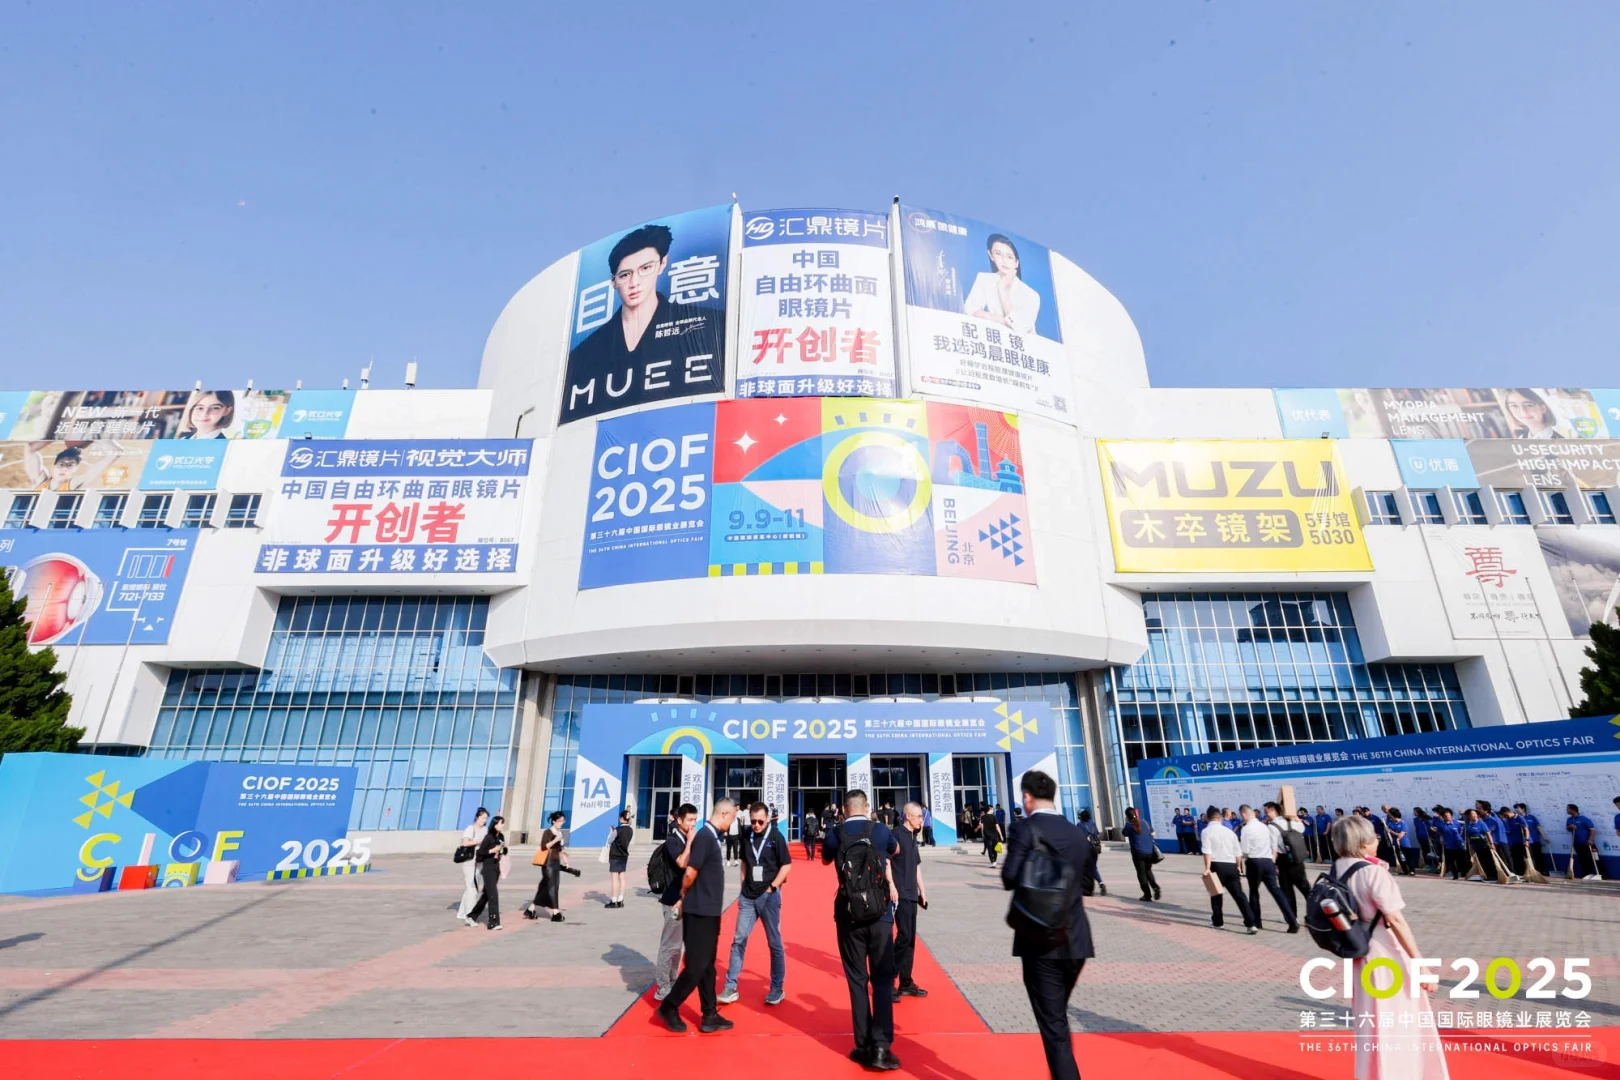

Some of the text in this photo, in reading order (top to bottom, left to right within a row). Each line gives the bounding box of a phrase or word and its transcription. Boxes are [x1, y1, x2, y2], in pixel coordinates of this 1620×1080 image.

[778, 217, 886, 240] 汇鼎镜片
[791, 249, 840, 269] 中国
[668, 254, 720, 305] 意
[755, 274, 878, 297] 自由环曲面
[778, 296, 853, 319] 眼镜片
[751, 326, 882, 365] 开创者
[933, 335, 1051, 376] 我选鸿晨眼健康
[569, 353, 713, 411] MUEE
[739, 378, 893, 398] 非球面升级好选择
[61, 406, 108, 418] NEW
[1383, 400, 1438, 410] MYOPIA
[54, 421, 156, 434] 近视管理镜片
[1387, 412, 1485, 423] MANAGEMENT
[1391, 425, 1425, 435] LENS
[315, 449, 401, 468] 汇鼎镜片
[406, 448, 528, 468] 视觉大师
[597, 433, 709, 480] CIOF
[1511, 444, 1604, 455] U-SECURITY
[281, 479, 521, 500] 中国自由环曲面眼镜片
[1109, 461, 1340, 498] MUZU
[1523, 473, 1562, 486] LENS
[591, 473, 706, 523] 2025
[324, 501, 466, 544] 开创者
[589, 519, 705, 540] 第三十六届中国国际眼镜业展览会
[729, 508, 804, 530] 9.9-11
[1133, 512, 1294, 544] 木卒镜架
[1305, 511, 1351, 528] 5号馆
[943, 498, 960, 565] BEIJING
[1309, 529, 1355, 545] 5030
[627, 539, 668, 549] INTERNATIONAL
[962, 541, 975, 566] 北京
[261, 548, 513, 572] 非球面升级好选择
[723, 718, 857, 740] CIOF 2025
[864, 718, 986, 729] 第三十六届中国国际眼镜业展览会
[1191, 735, 1595, 773] CIOF 2025 第三十六届中国国际眼镜业展览会 THE 36TH CHINA INTERNATIONAL OPTICS FAIR
[242, 775, 340, 791] CIOF 2025
[581, 777, 611, 799] 1A
[683, 773, 691, 802] WELCO
[932, 772, 942, 813] WELCOME
[941, 772, 953, 813] 欢迎参观
[79, 829, 244, 869] CIOF
[275, 837, 371, 871] 2025
